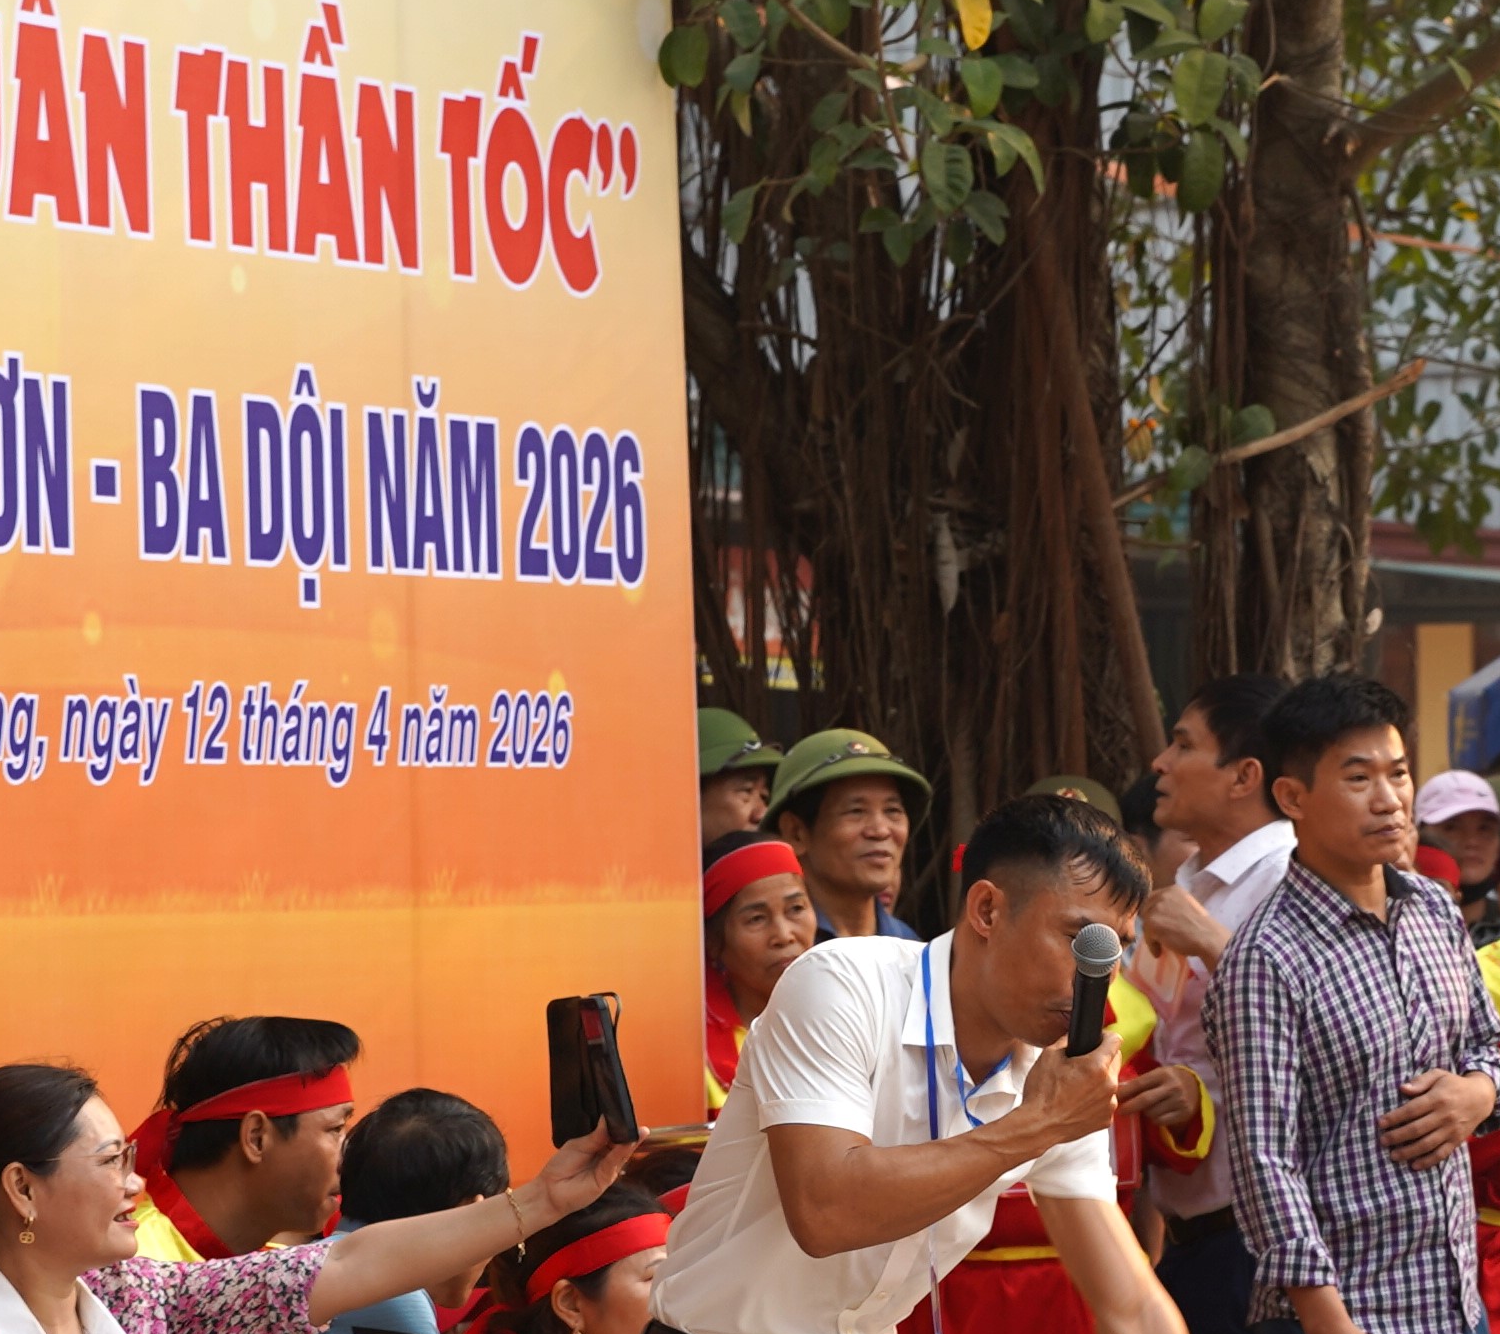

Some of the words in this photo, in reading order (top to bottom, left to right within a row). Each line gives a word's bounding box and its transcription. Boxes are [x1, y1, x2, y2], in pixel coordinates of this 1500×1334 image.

[175, 1, 421, 271] THẦN
[139, 389, 228, 559] BA
[246, 369, 347, 602] DỘI
[366, 380, 500, 575] NĂM
[515, 425, 644, 584] 2026
[62, 676, 168, 784] ngày
[184, 683, 228, 763] 12
[241, 680, 355, 785] tháng
[366, 688, 390, 763] 4
[399, 686, 478, 766] năm
[488, 690, 573, 768] 2026
